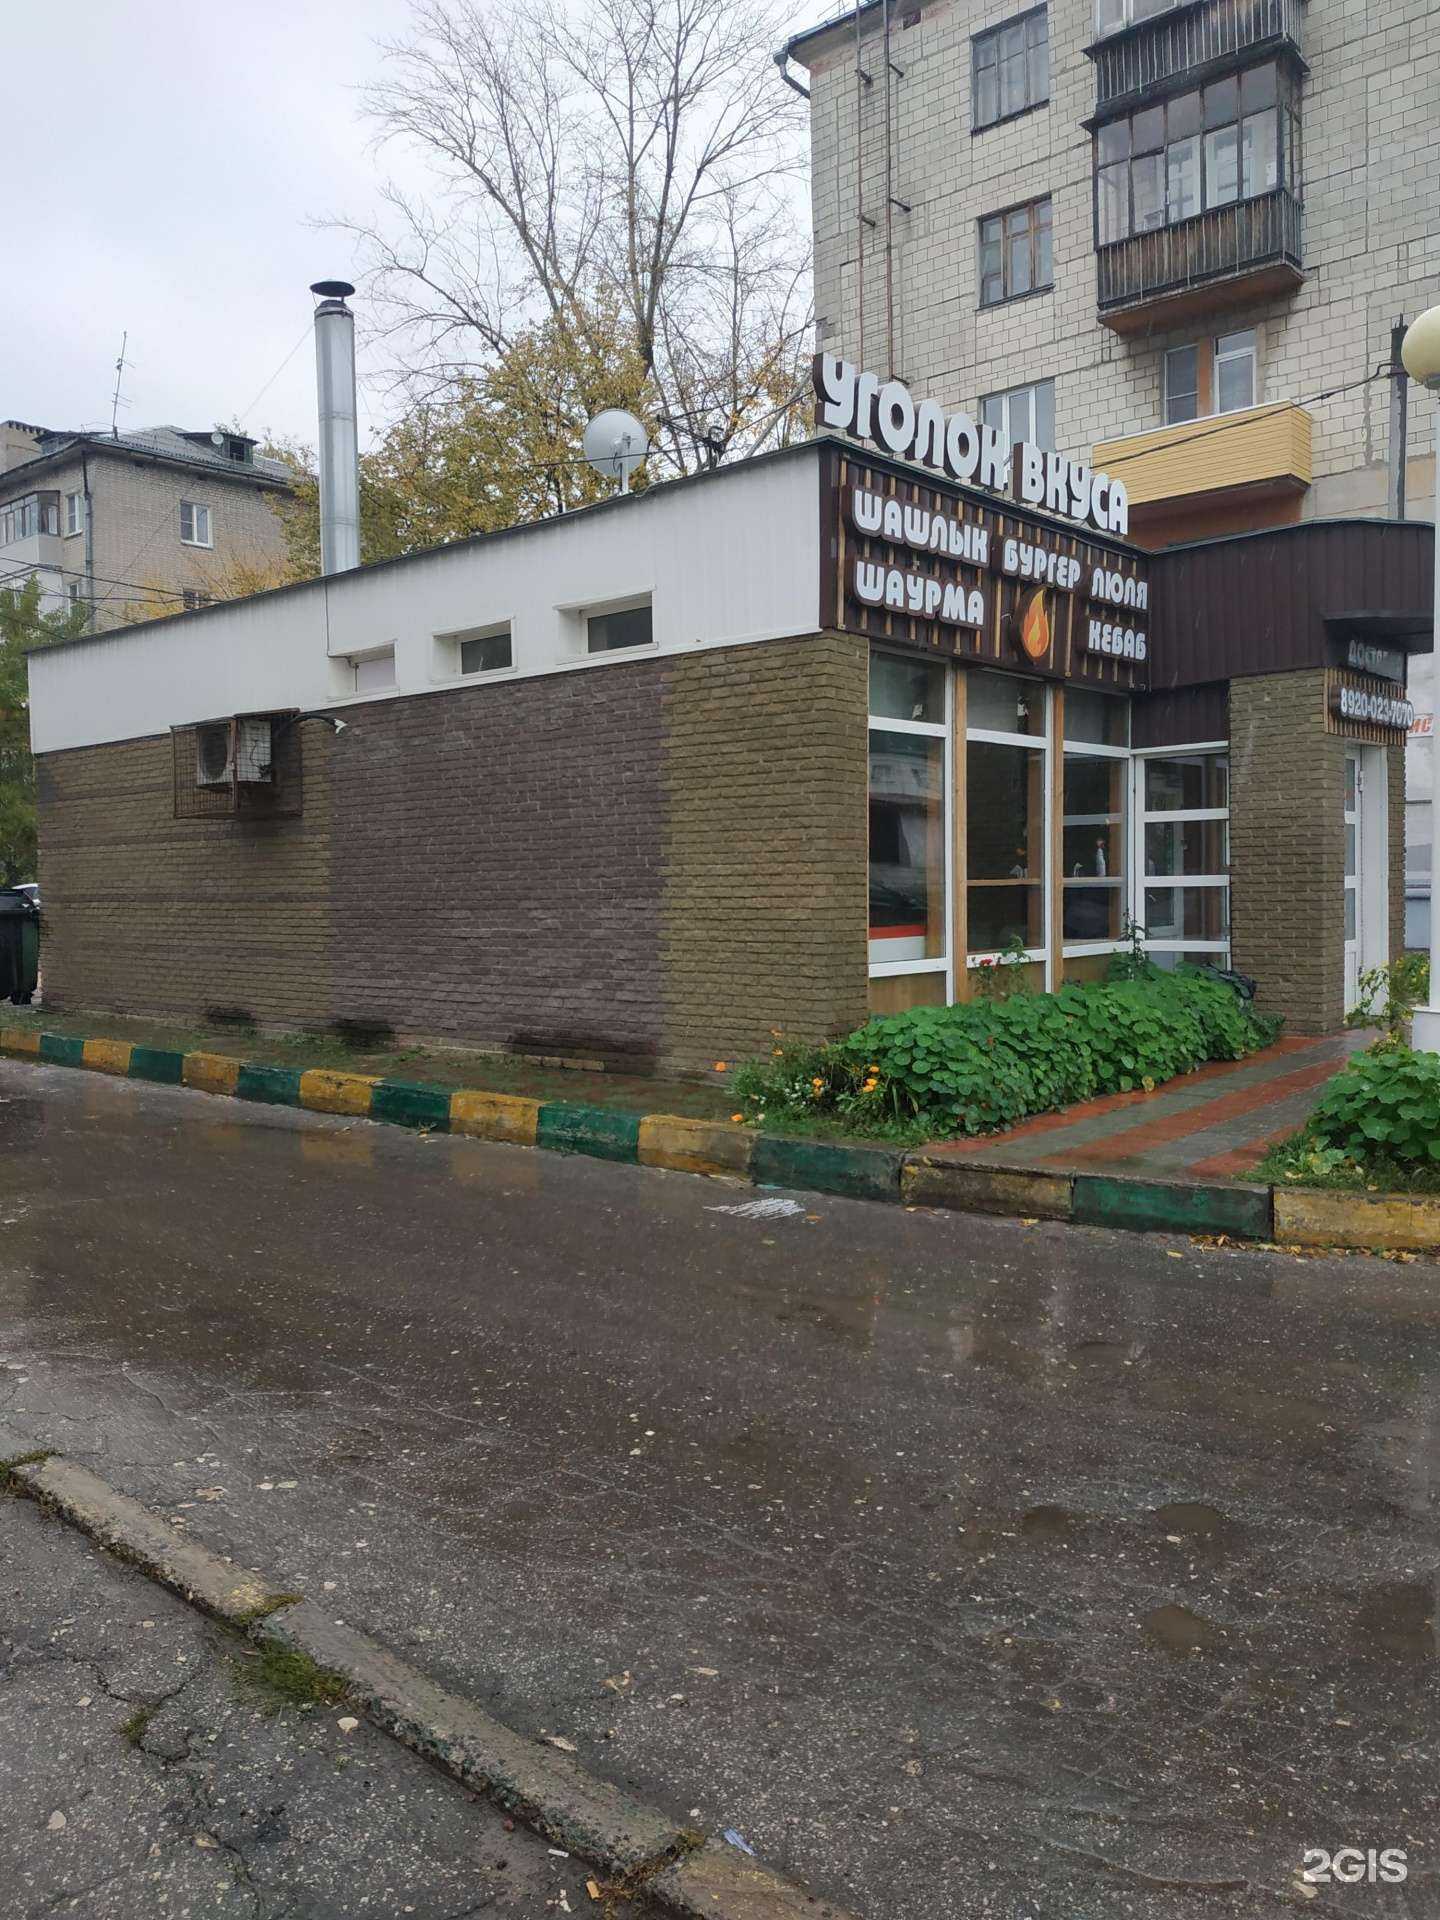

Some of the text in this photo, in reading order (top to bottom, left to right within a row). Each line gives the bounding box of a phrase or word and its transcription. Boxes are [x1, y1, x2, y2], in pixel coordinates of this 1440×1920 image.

[821, 353, 1129, 536] УГОЛОК ВКУСА
[854, 489, 989, 564] ШАШЛЫК
[856, 560, 985, 626] ШАУРМА
[1003, 538, 1081, 590] БУРГЕР
[1091, 566, 1148, 611] ЛЮЛЯ
[1088, 620, 1147, 661] КЕБАБ
